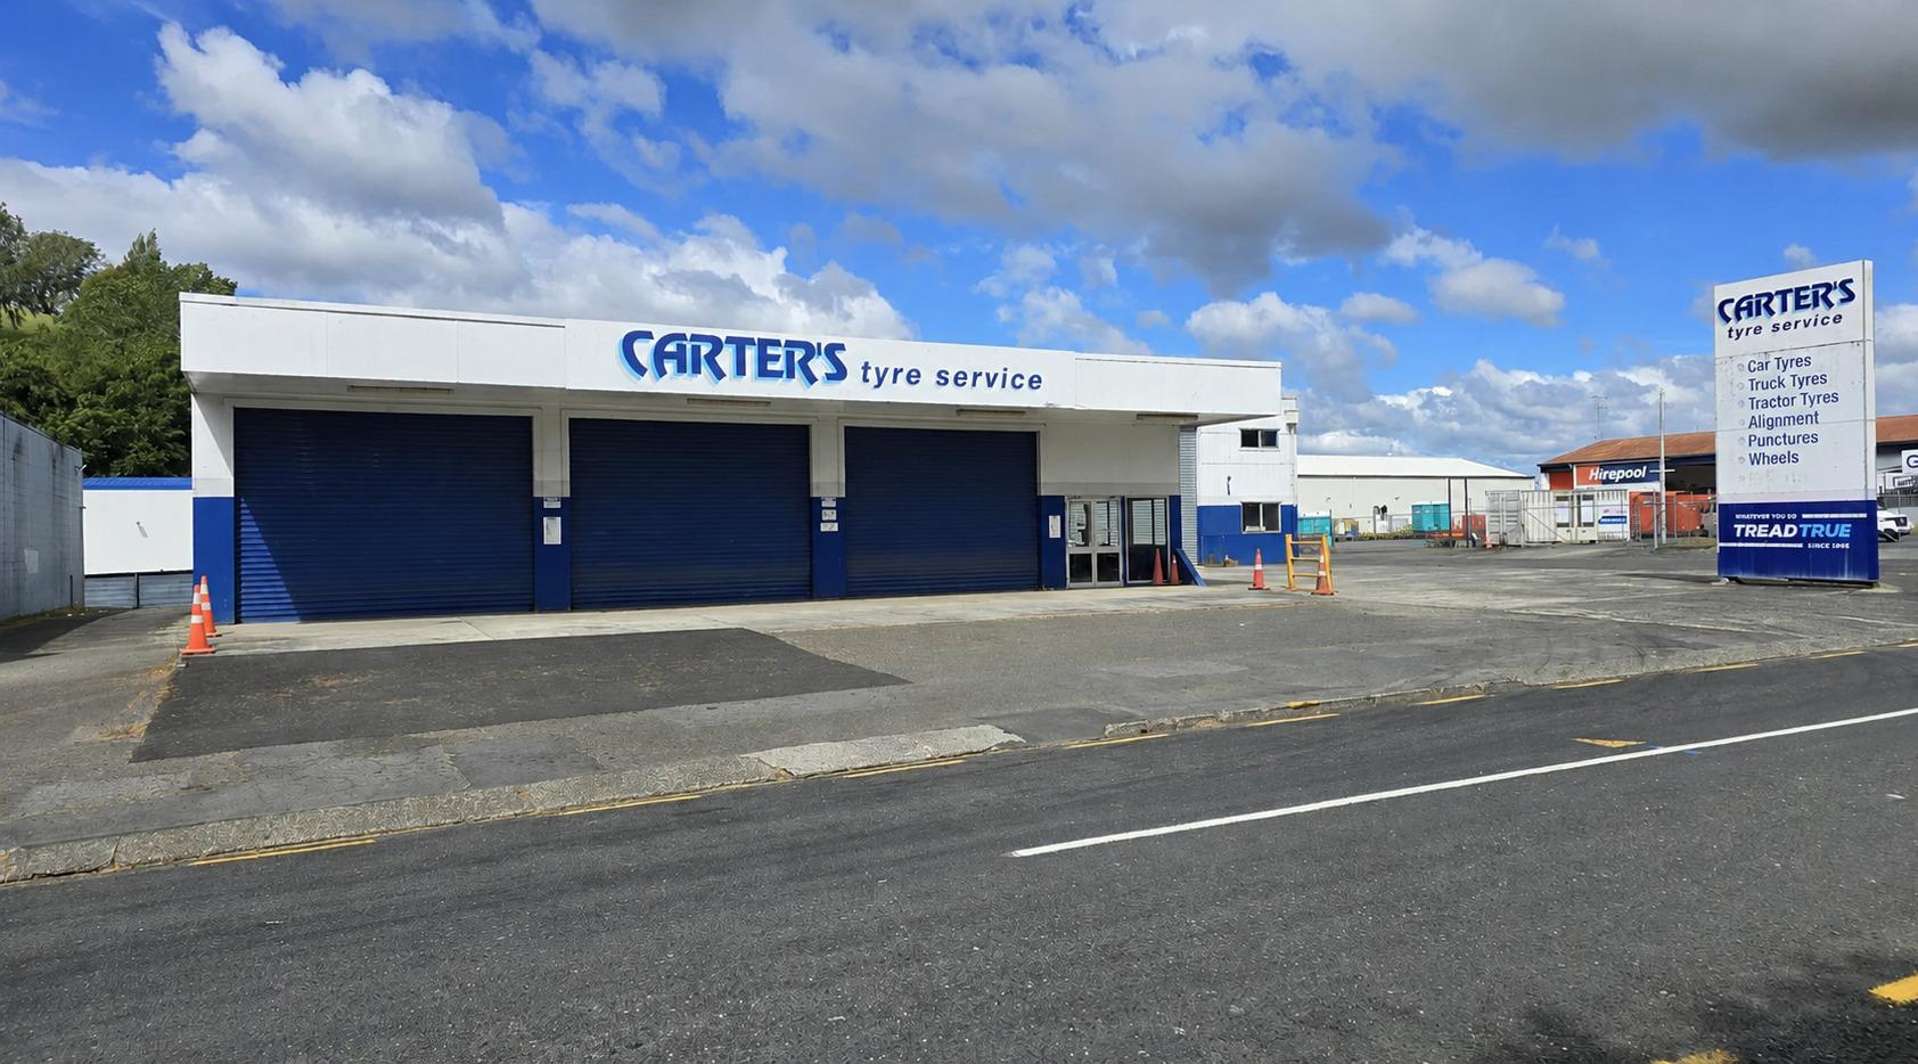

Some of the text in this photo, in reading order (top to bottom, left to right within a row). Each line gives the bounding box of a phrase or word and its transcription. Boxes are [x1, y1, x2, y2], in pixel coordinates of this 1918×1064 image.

[1718, 278, 1856, 324] CARTER'S
[1727, 314, 1843, 341] tyre service
[620, 330, 1043, 390] CARTER'S tyre service
[1748, 355, 1812, 373] Car Tyres
[1748, 373, 1828, 391] Truck Tyres
[1749, 391, 1839, 410] Tractor Tyres
[1748, 410, 1819, 430] Alignment
[1749, 432, 1819, 447] Punctures
[1749, 451, 1799, 466] Wheels
[1588, 465, 1647, 482] Hirepool
